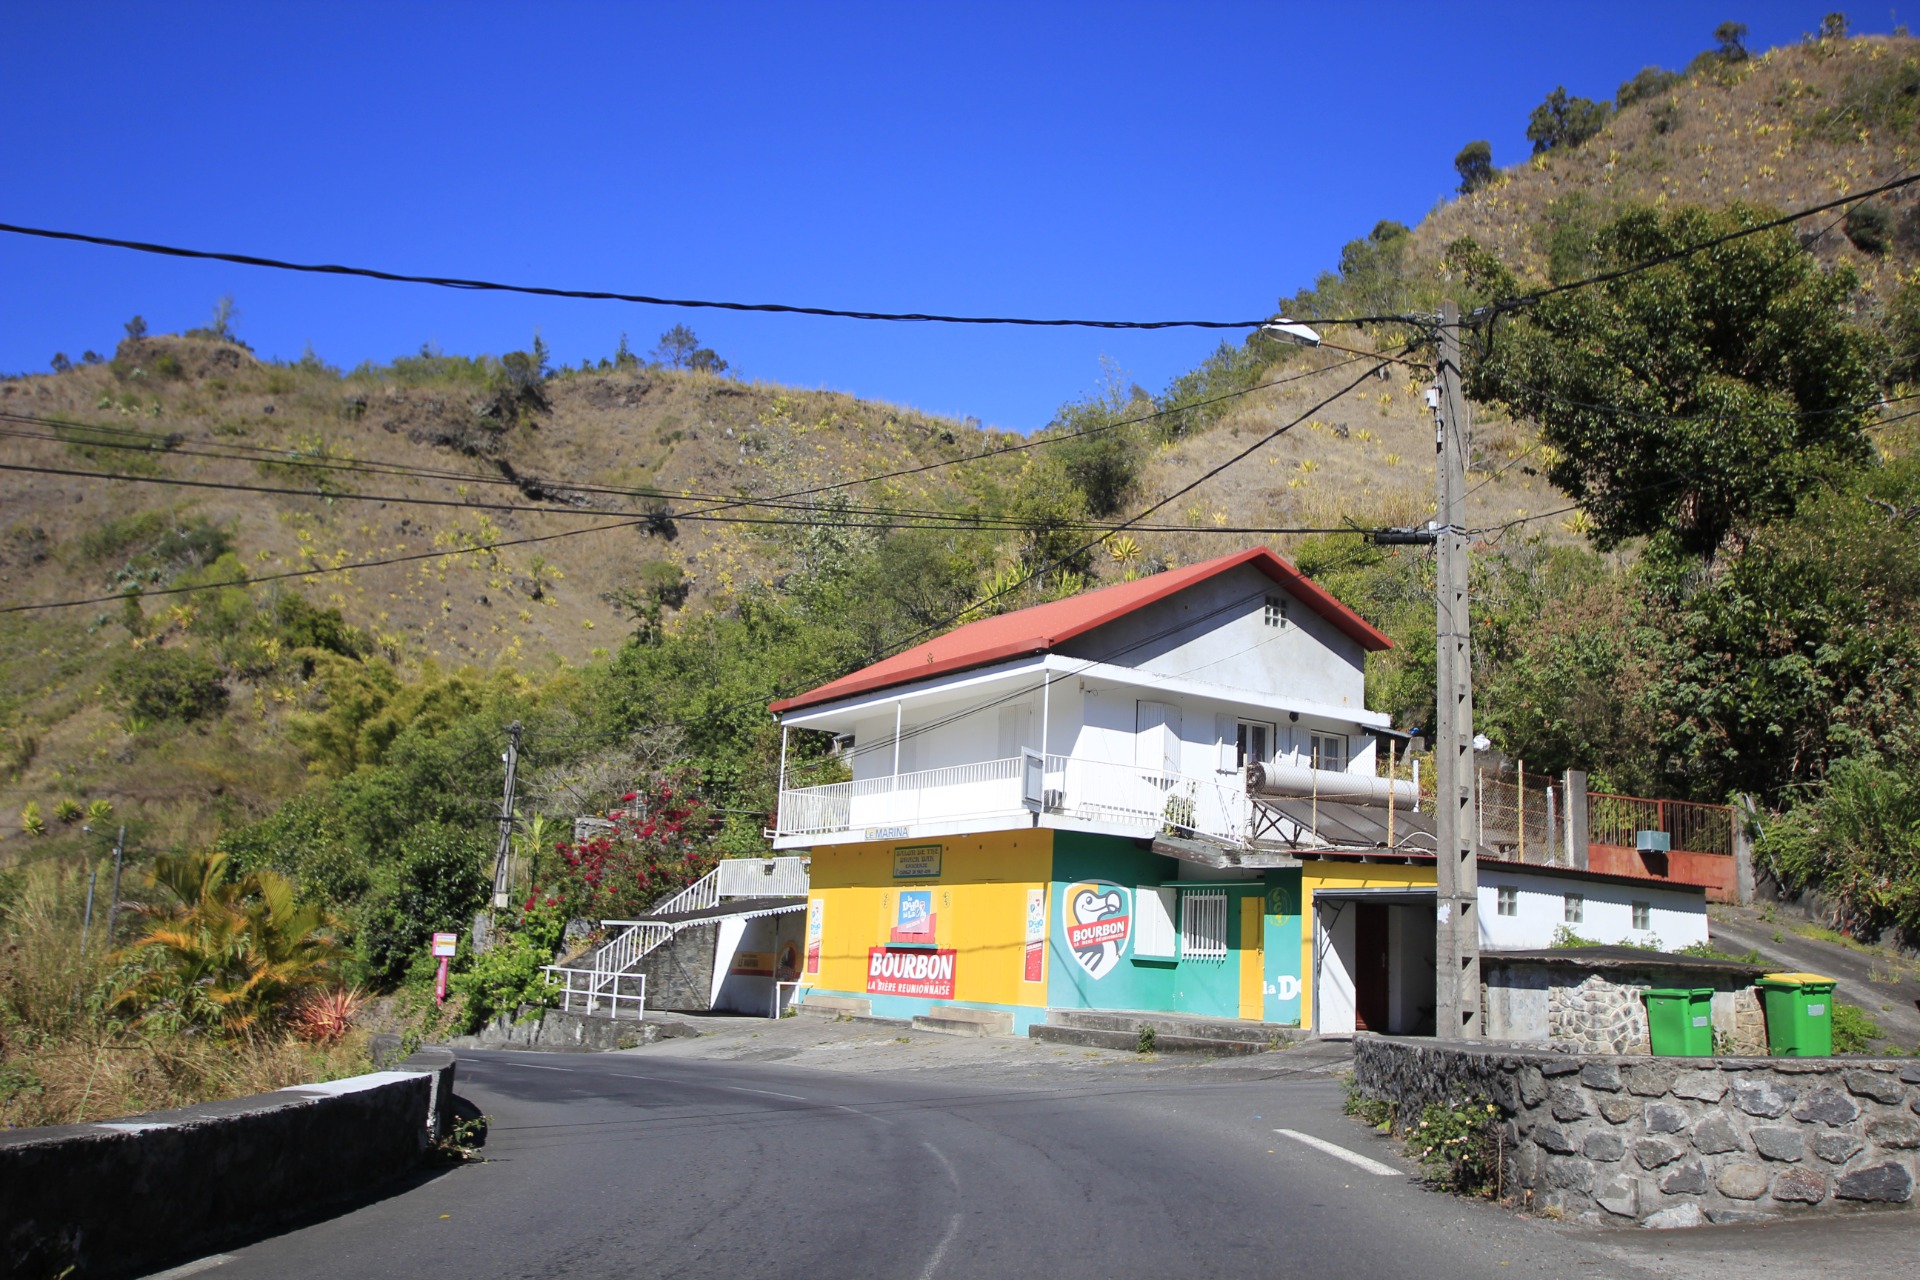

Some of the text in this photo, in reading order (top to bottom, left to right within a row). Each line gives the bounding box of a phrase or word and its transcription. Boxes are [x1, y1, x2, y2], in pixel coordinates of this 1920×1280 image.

[875, 826, 908, 838] MARINA
[1073, 921, 1125, 942] BOURBON
[870, 952, 953, 980] BOURBON
[867, 981, 876, 990] LA
[1263, 980, 1277, 995] la
